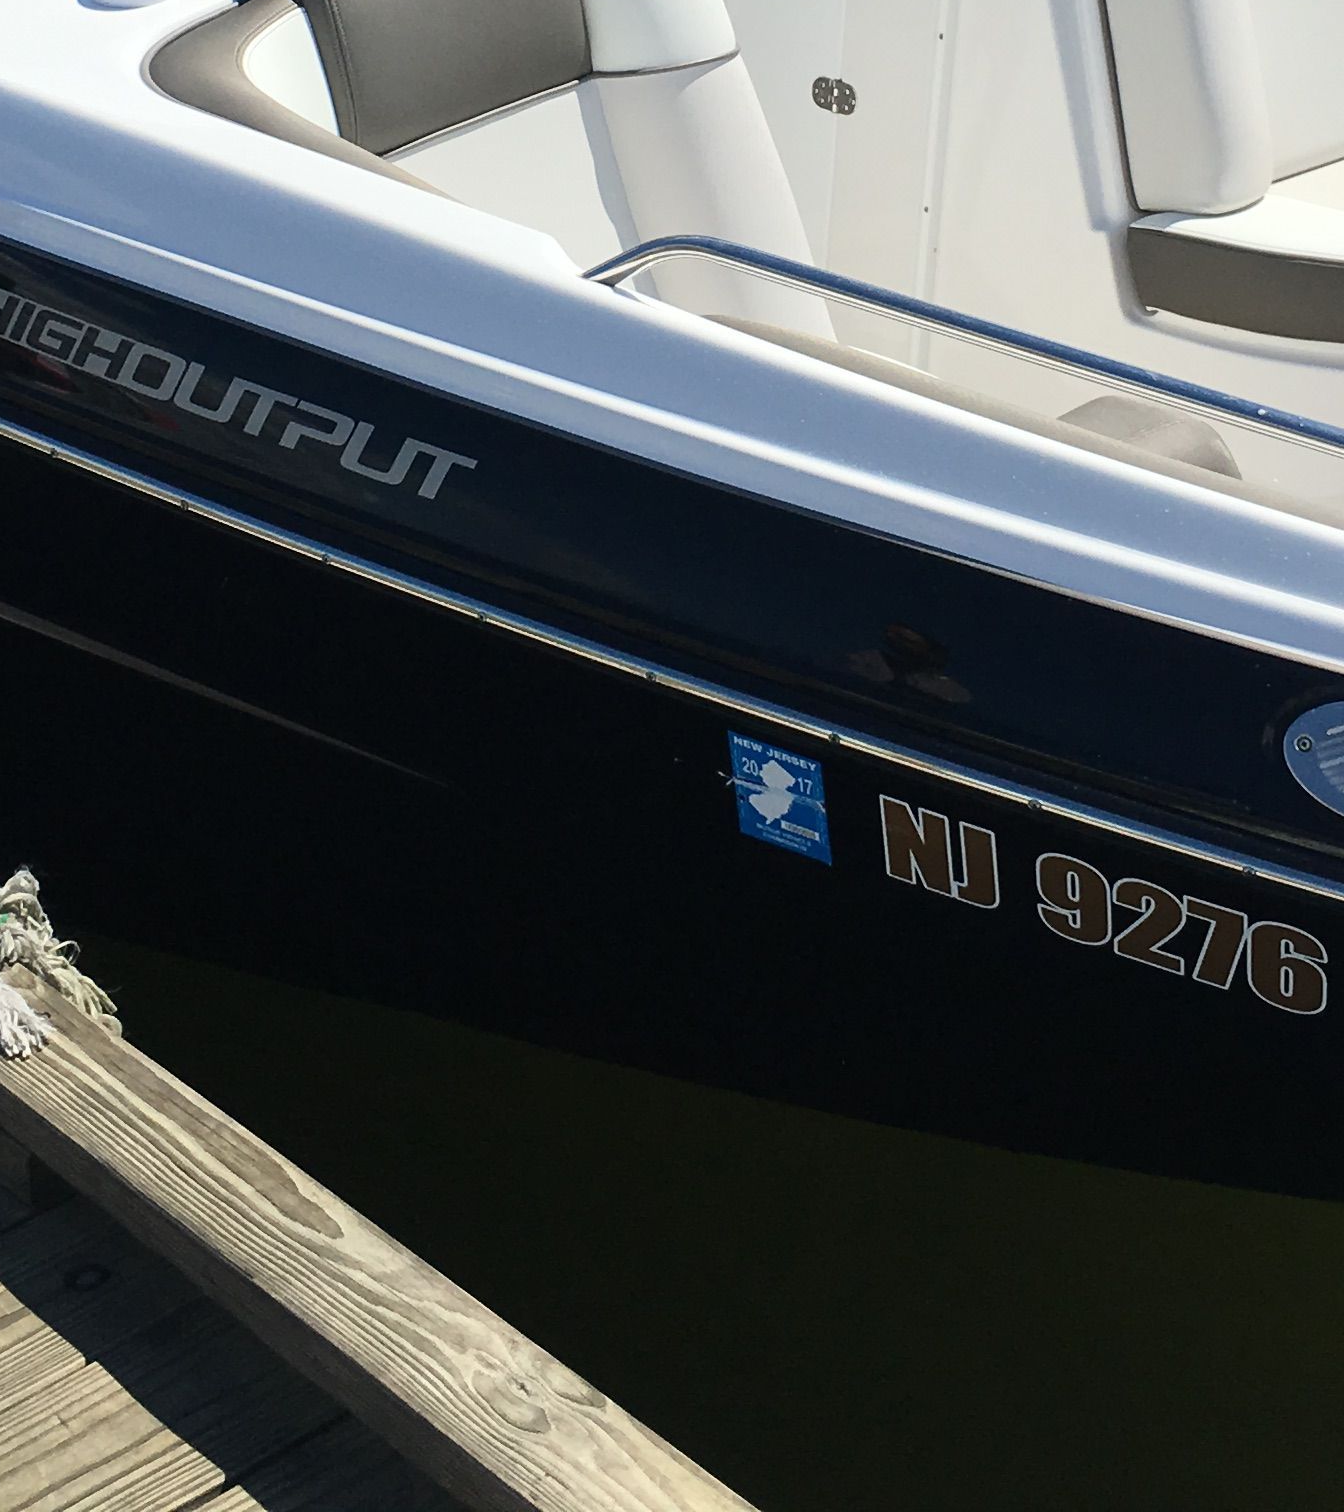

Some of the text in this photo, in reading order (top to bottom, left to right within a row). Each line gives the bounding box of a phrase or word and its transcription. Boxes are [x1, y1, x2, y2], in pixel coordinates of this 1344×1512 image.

[733, 735, 816, 771] NEW JERSEY
[741, 757, 758, 776] 20
[797, 777, 813, 795] 17
[879, 793, 1000, 910] NJ
[1035, 851, 1329, 1015] 9276
